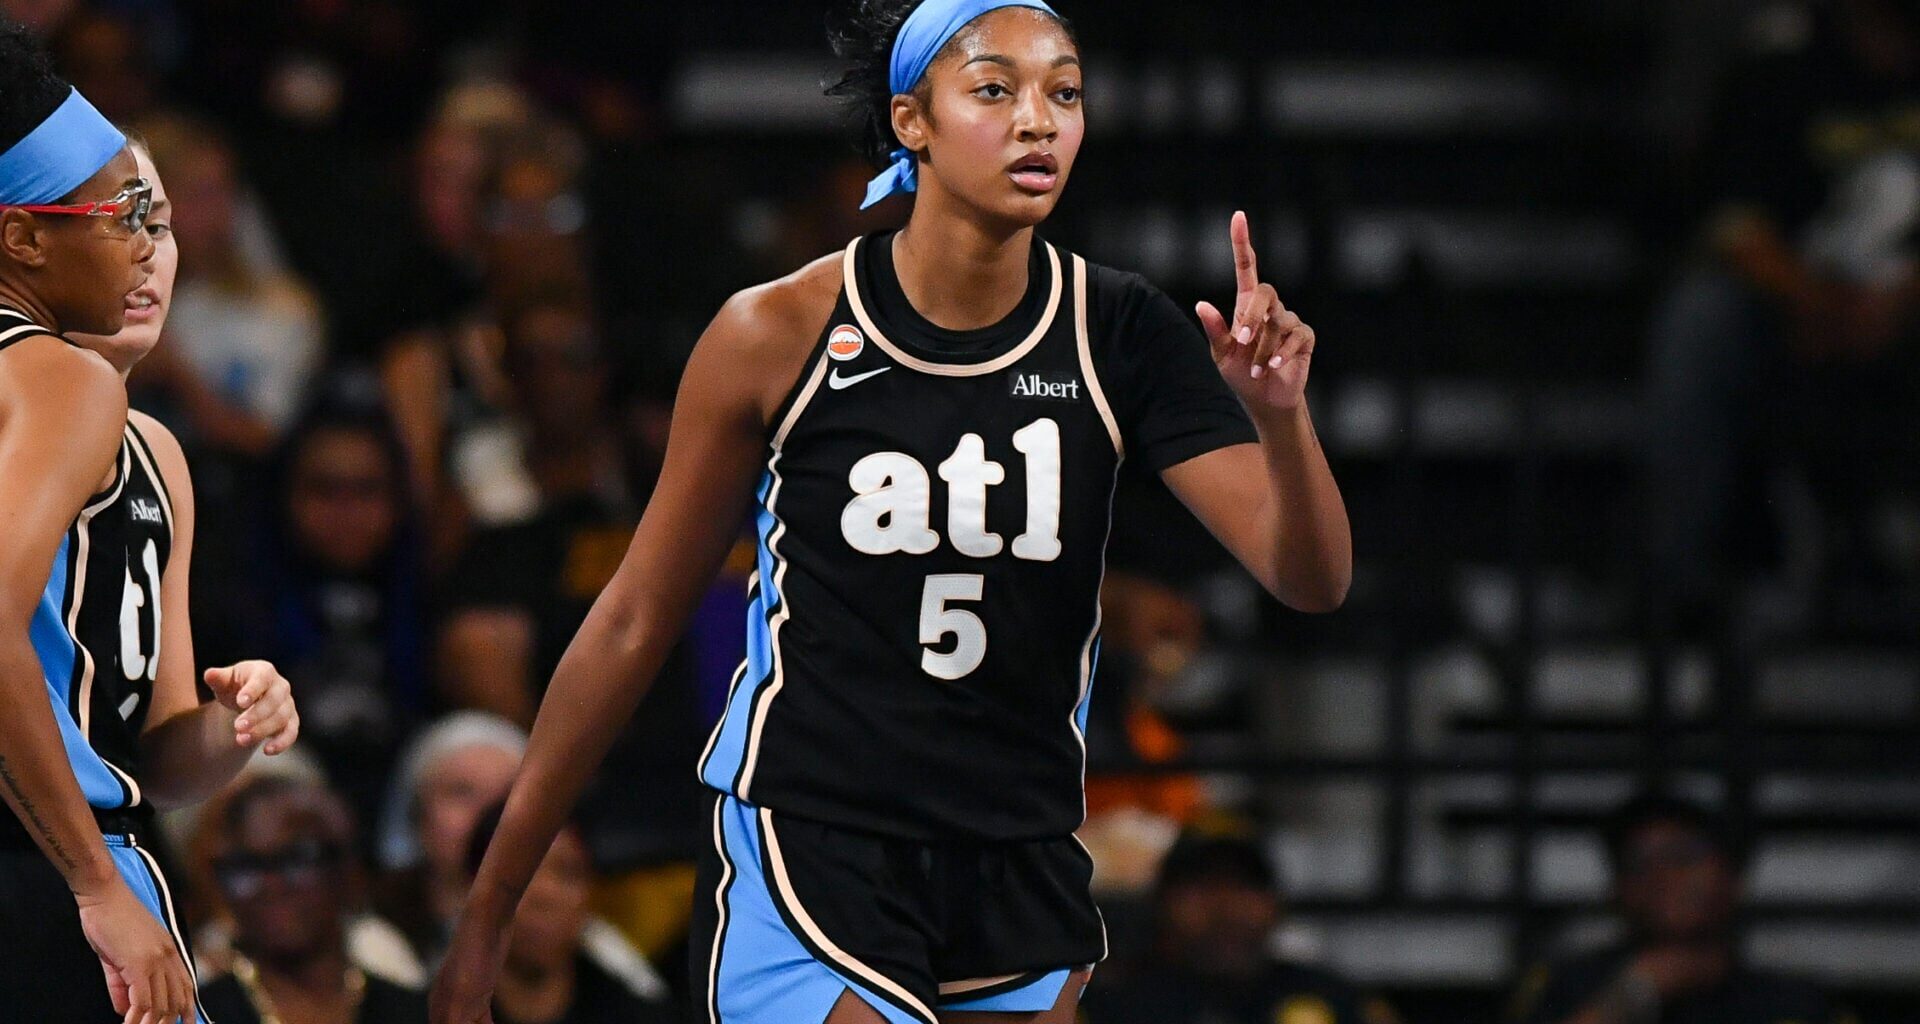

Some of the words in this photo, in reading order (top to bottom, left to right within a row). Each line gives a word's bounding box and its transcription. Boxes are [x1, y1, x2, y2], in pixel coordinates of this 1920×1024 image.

[1012, 373, 1080, 400] Albert
[130, 498, 163, 524] Albert
[840, 417, 1062, 562] atl
[918, 573, 988, 681] 5
